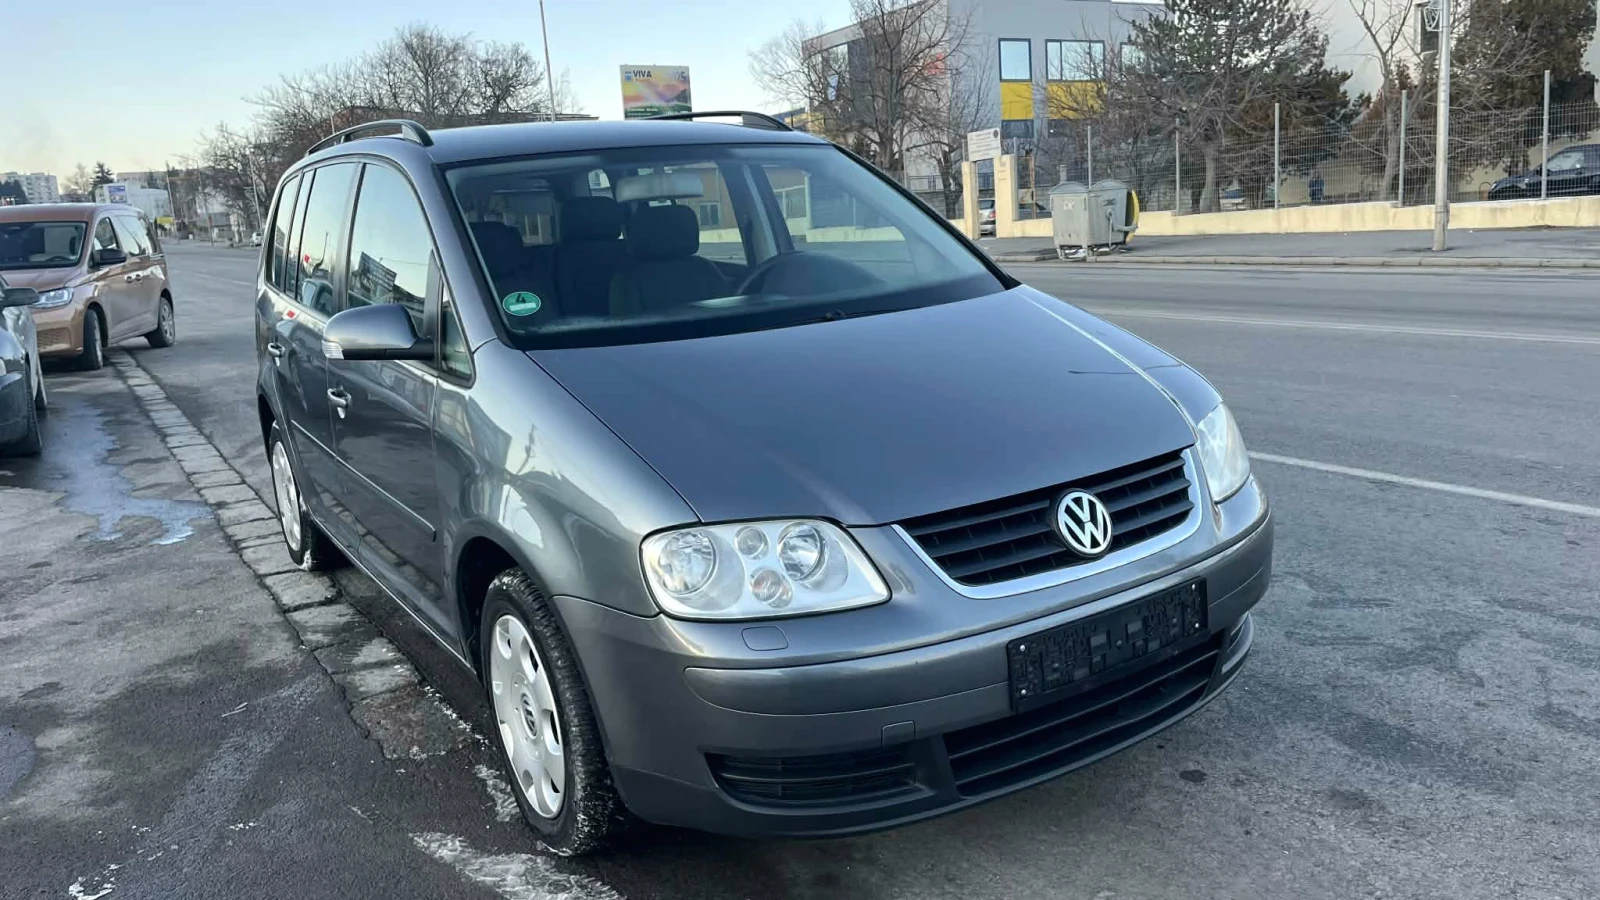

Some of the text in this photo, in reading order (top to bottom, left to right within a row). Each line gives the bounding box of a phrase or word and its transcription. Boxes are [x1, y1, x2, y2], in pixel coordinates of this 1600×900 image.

[633, 70, 652, 78] VIVA
[516, 293, 526, 303] 4
[1058, 492, 1111, 553] VW
